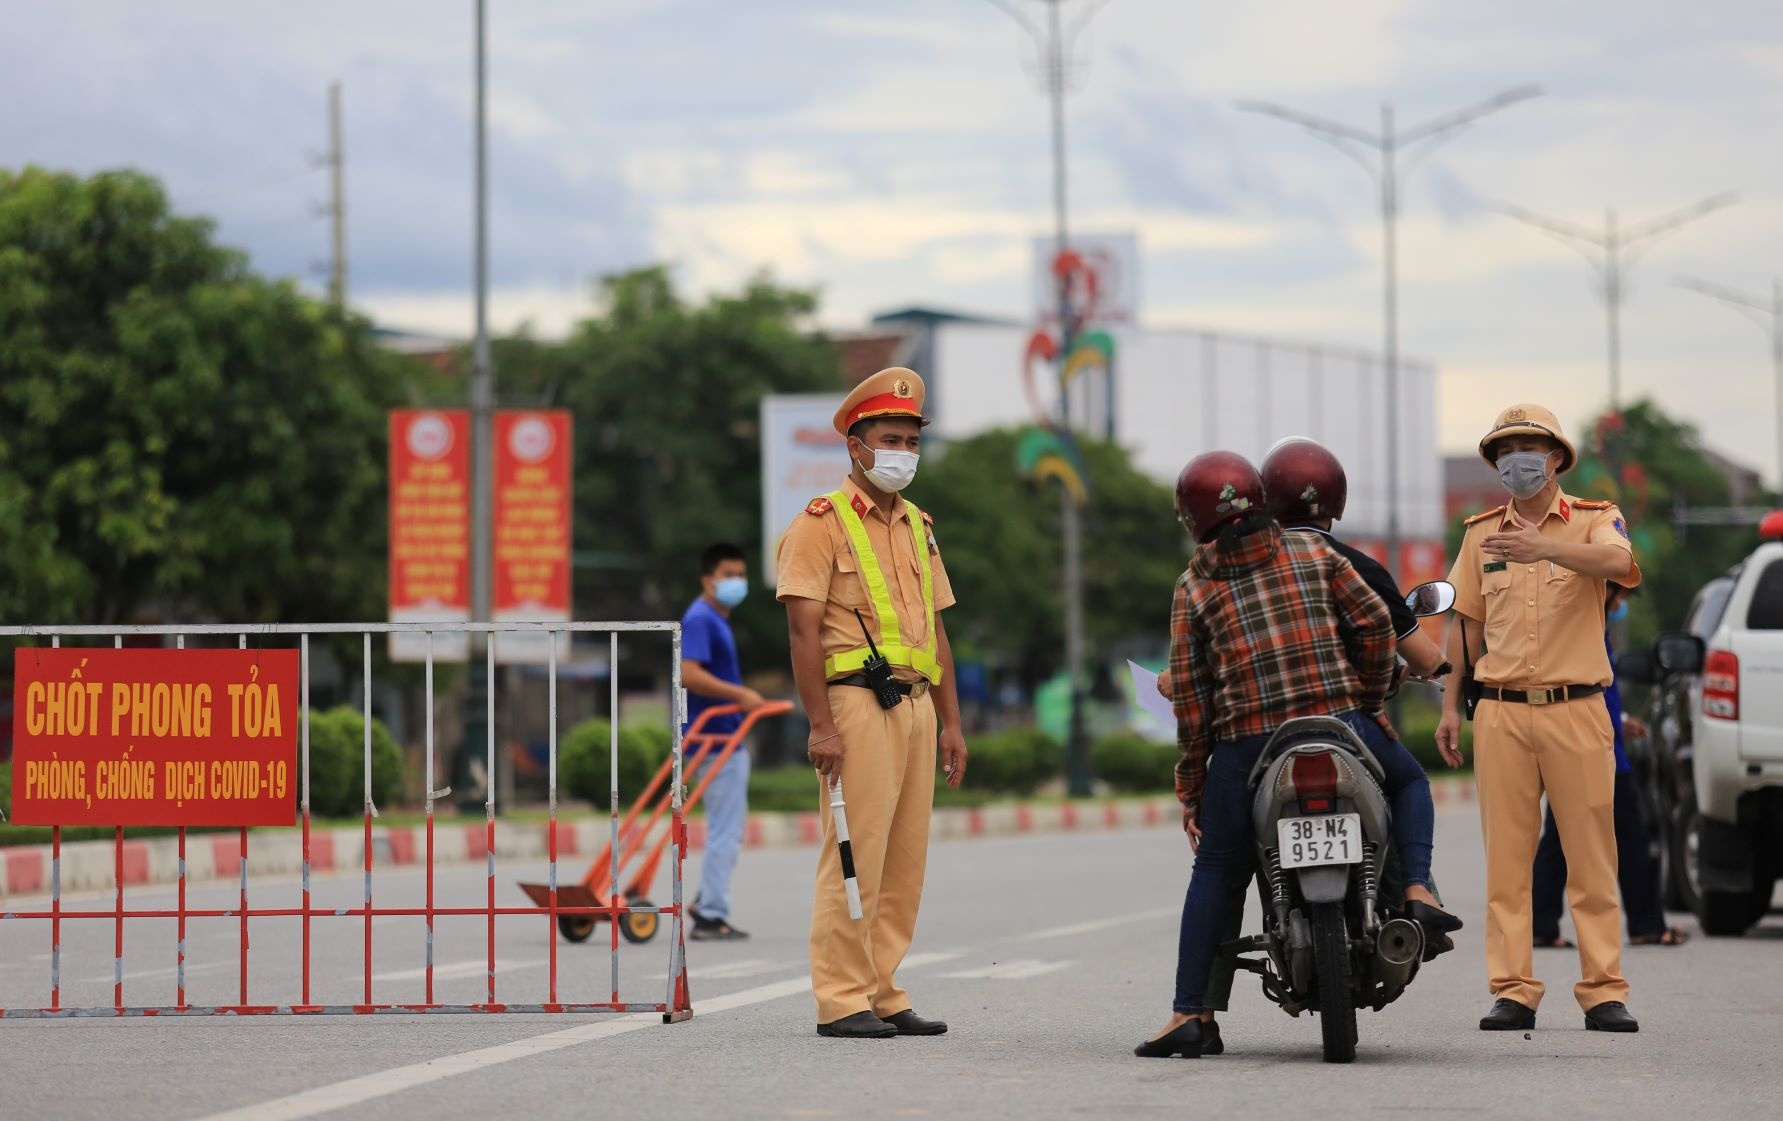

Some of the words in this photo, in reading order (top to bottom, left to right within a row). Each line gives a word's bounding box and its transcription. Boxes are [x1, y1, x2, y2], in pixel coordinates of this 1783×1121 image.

[26, 657, 103, 736] CHỐT
[111, 682, 212, 737] PHONG
[227, 664, 282, 738] TỎA
[26, 752, 92, 810] PHÒNG,
[96, 745, 155, 800] CHỐNG
[165, 760, 206, 808] DỊCH
[210, 760, 287, 800] COVID-19
[1292, 839, 1349, 863] 9521
